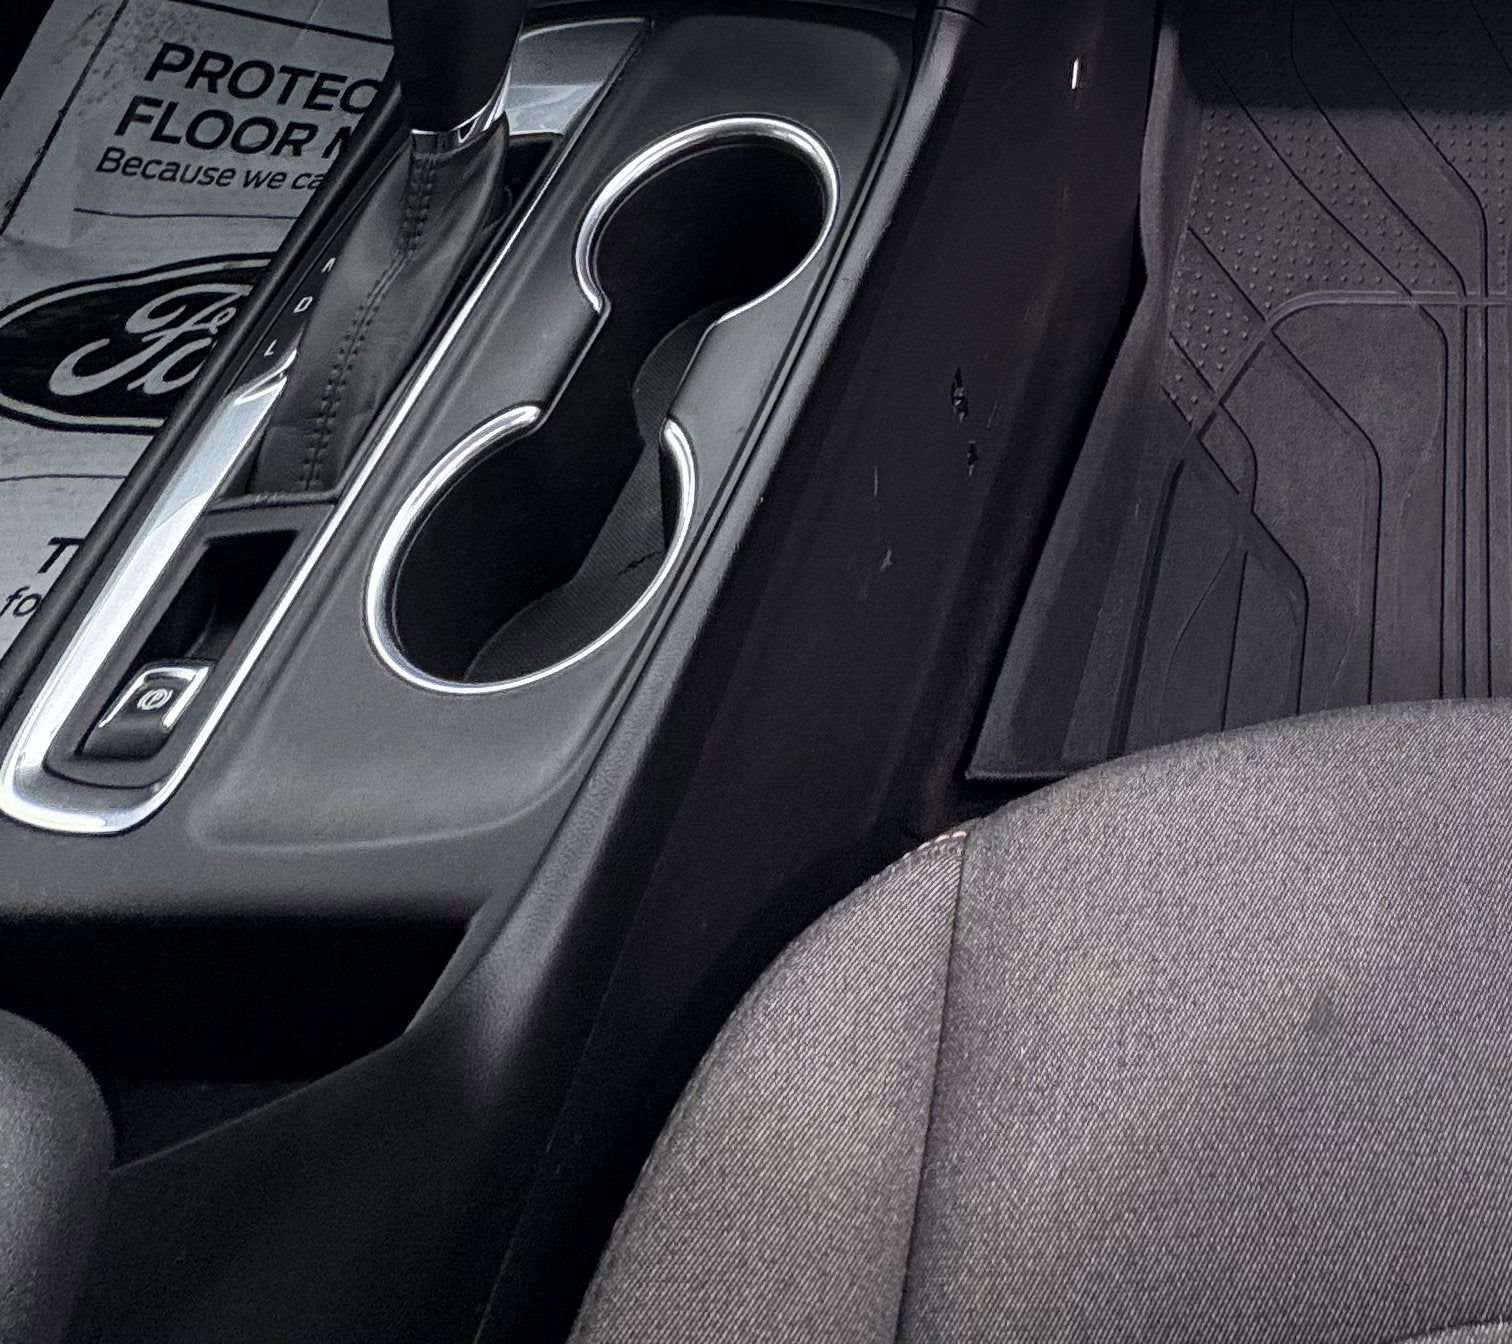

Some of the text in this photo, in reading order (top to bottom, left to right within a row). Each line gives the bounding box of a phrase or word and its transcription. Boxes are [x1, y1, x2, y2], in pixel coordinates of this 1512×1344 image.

[114, 95, 318, 157] FLOOR
[95, 146, 237, 188] Because
[243, 169, 288, 190] we
[293, 295, 314, 313] D
[263, 338, 278, 357] L
